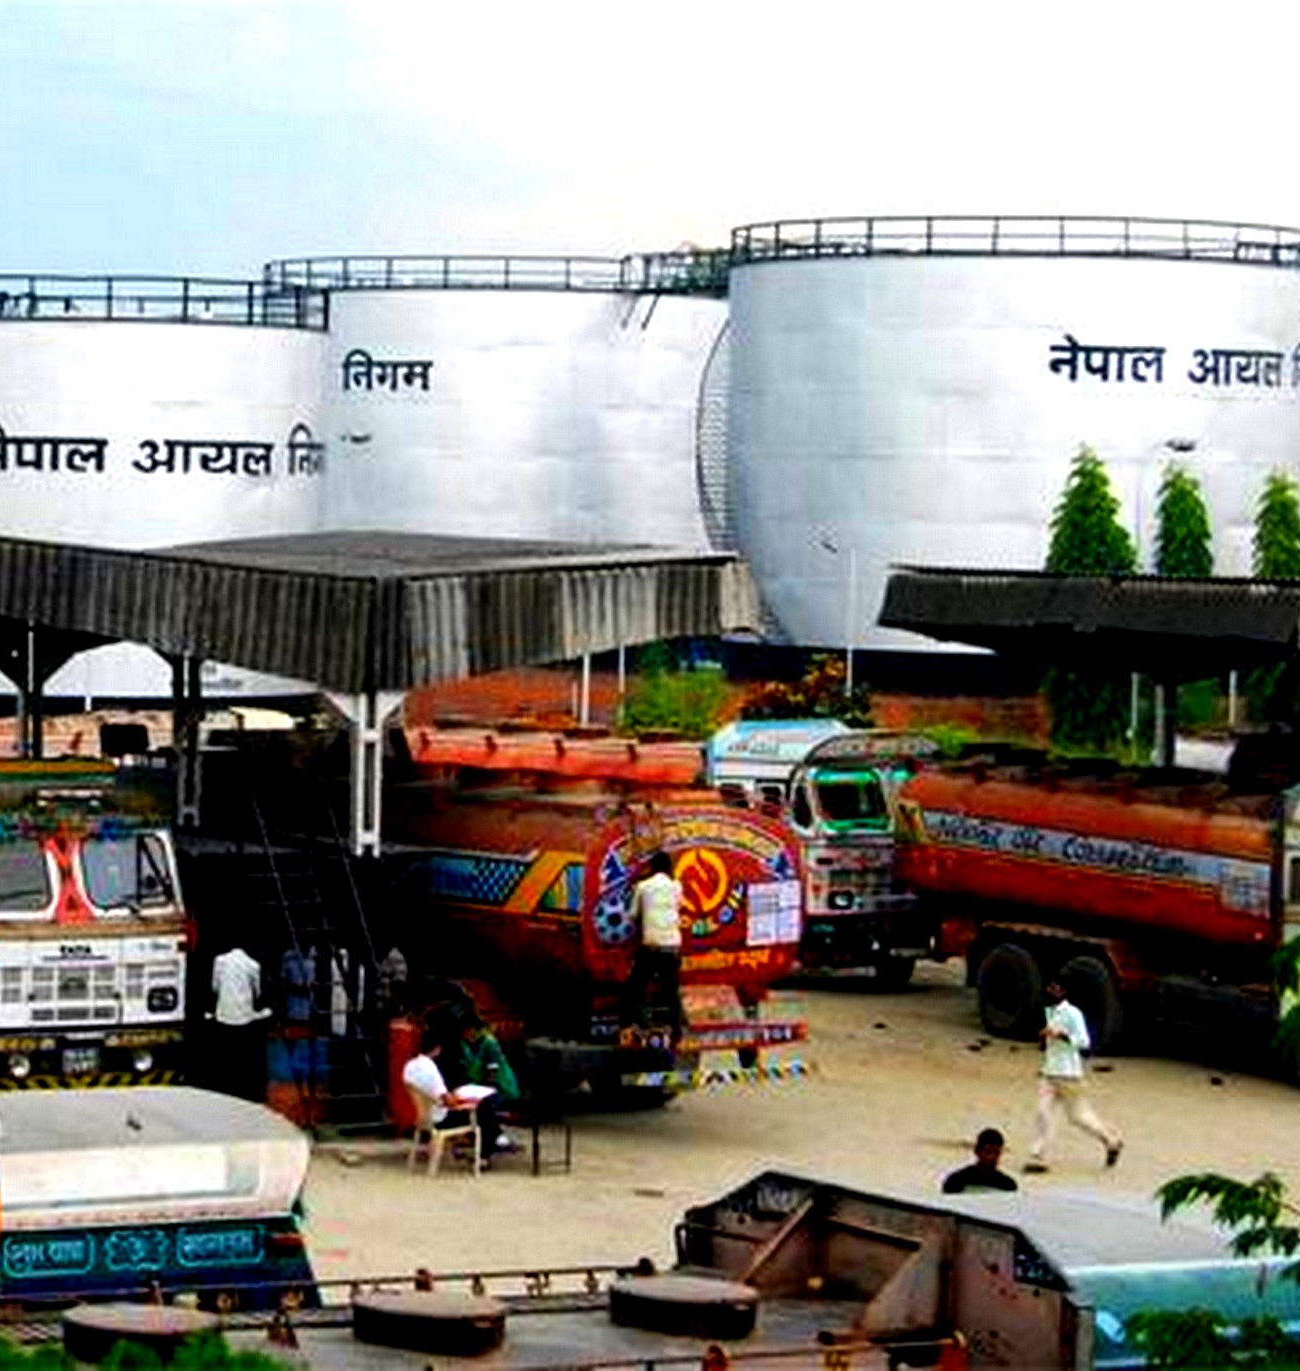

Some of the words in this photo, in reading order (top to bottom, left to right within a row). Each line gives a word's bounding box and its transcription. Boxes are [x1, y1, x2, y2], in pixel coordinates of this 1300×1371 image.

[341, 348, 434, 391] निगम
[1049, 334, 1167, 382] नेपाल
[1188, 349, 1284, 387] आयल
[132, 439, 274, 477] आयल
